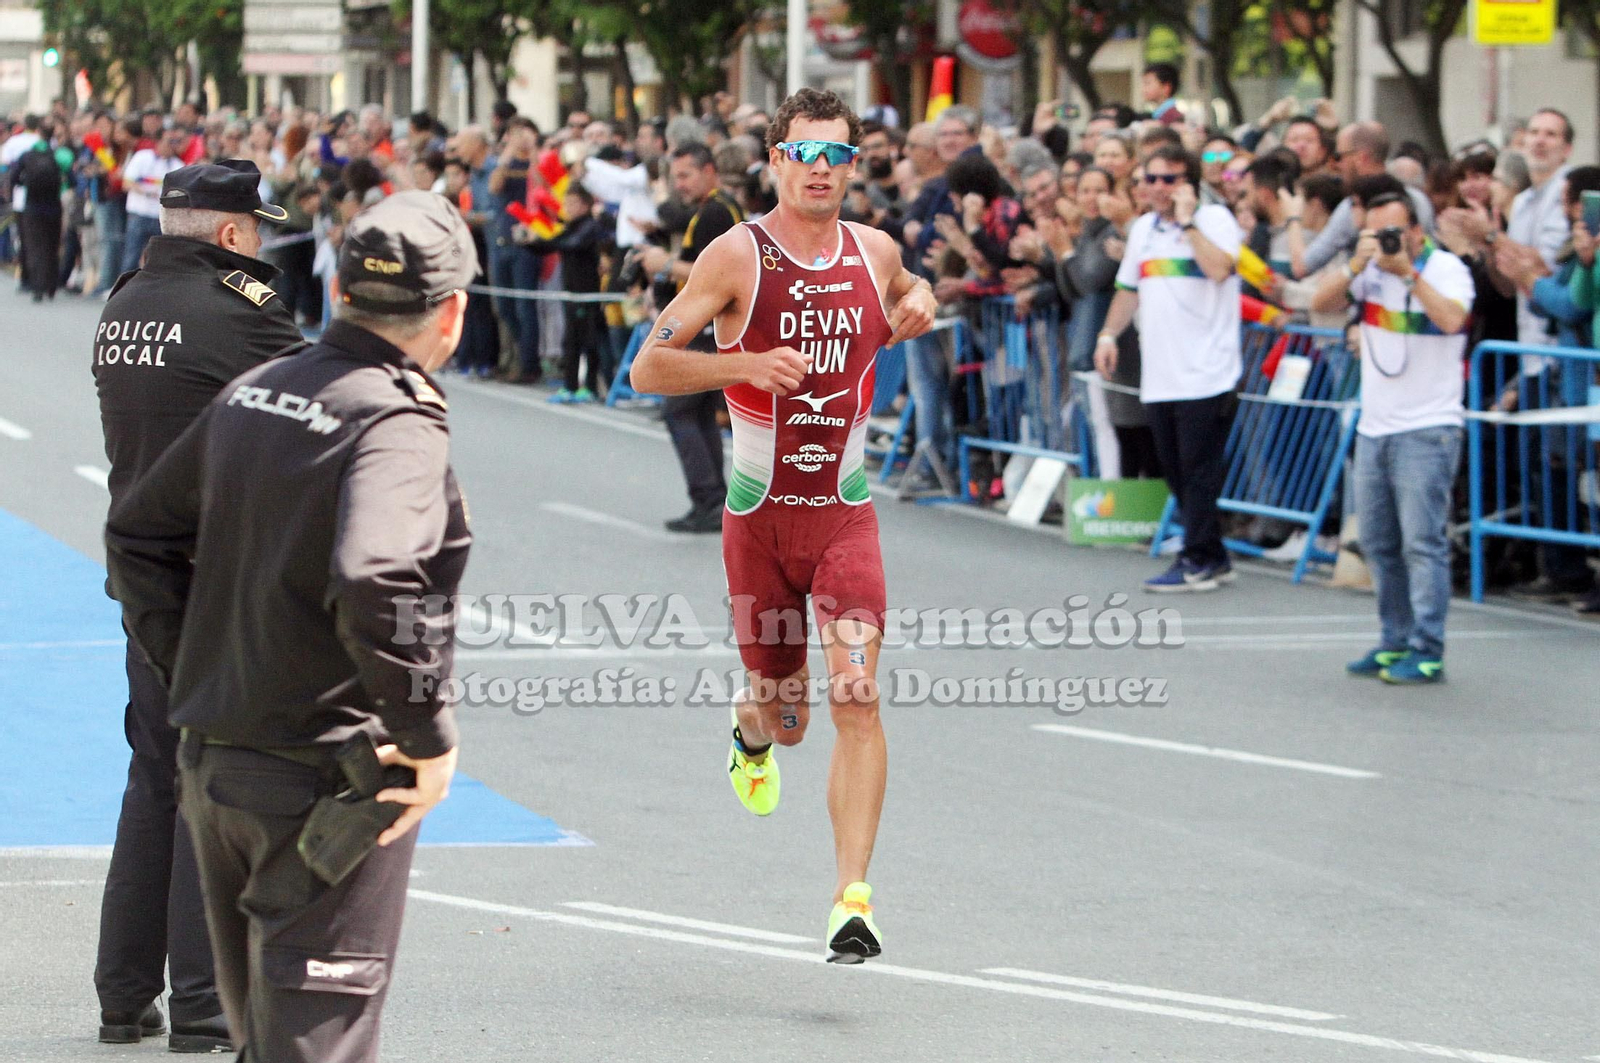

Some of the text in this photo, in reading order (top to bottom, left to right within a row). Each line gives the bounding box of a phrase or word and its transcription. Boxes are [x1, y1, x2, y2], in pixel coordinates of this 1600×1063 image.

[803, 281, 853, 294] CUBE
[779, 301, 863, 340] DÉVAY
[96, 320, 183, 344] POLICIA
[656, 326, 674, 341] 3
[98, 344, 166, 367] LOCAL
[801, 338, 850, 375] HUN
[781, 451, 837, 465] cerbona
[768, 494, 838, 507] YONDA
[781, 714, 798, 730] 3
